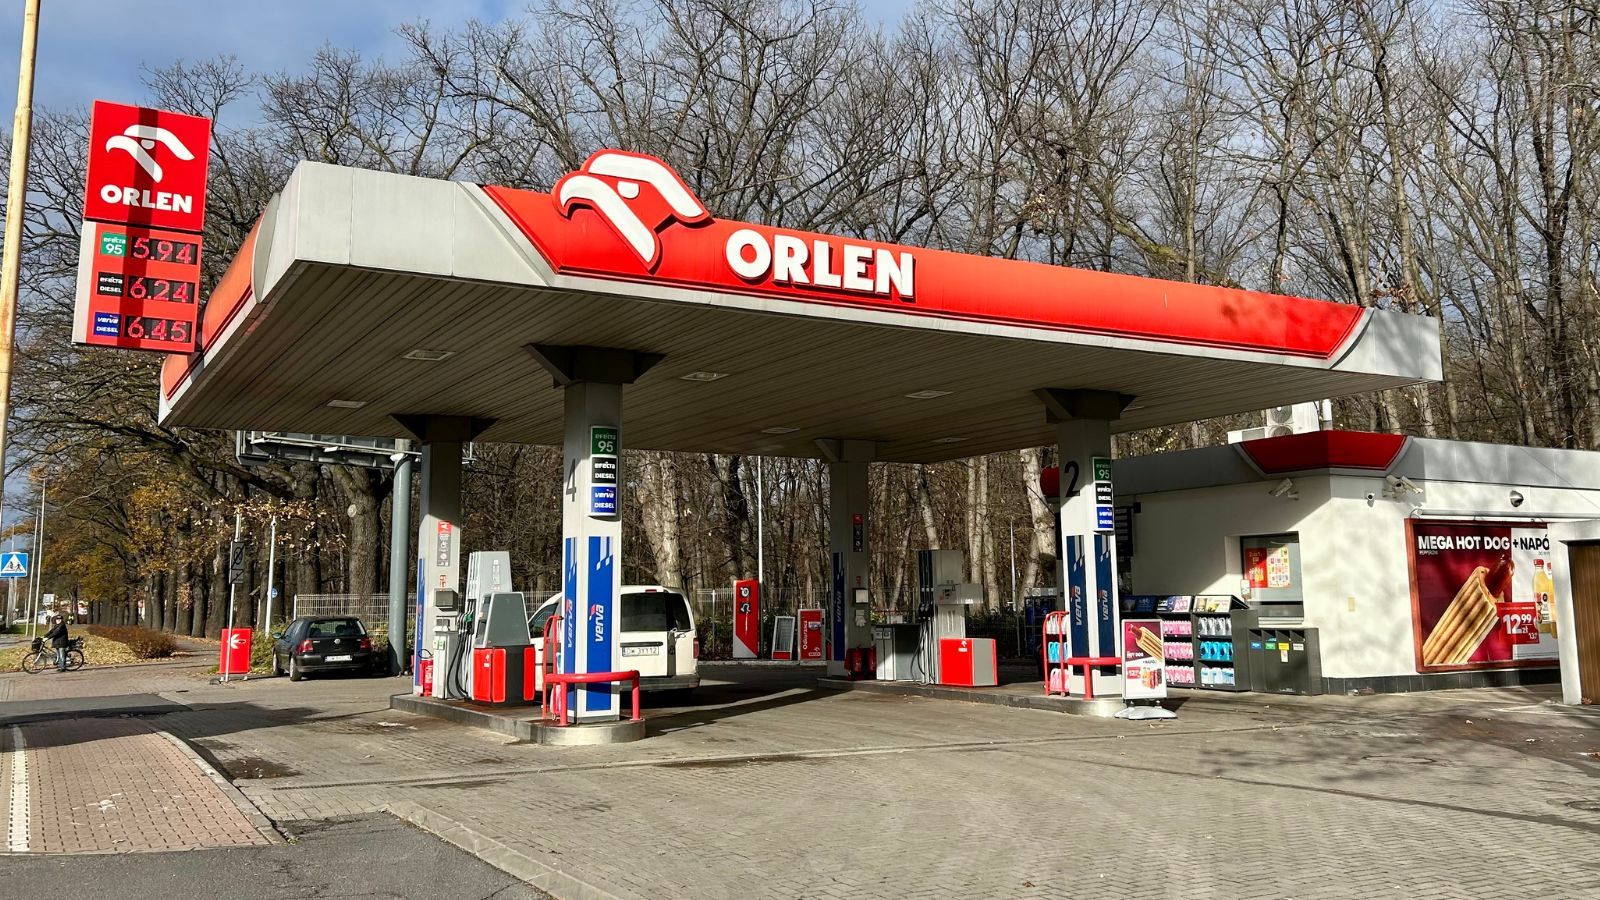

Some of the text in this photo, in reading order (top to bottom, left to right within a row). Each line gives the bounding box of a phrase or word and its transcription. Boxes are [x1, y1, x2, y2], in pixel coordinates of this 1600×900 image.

[100, 185, 192, 214] ORLEN
[105, 244, 122, 255] 95
[133, 238, 191, 264] 5.94
[726, 229, 914, 298] ORLEN
[130, 277, 189, 303] 6.24
[127, 317, 186, 342] 6.45
[598, 441, 613, 453] 95
[566, 458, 577, 502] 4
[1064, 461, 1080, 497] 2
[1098, 470, 1110, 479] 95
[1418, 536, 1454, 550] MEGA
[1456, 536, 1480, 550] HOT
[1484, 537, 1510, 550] DOG
[595, 604, 604, 642] verva
[1503, 614, 1522, 635] 12
